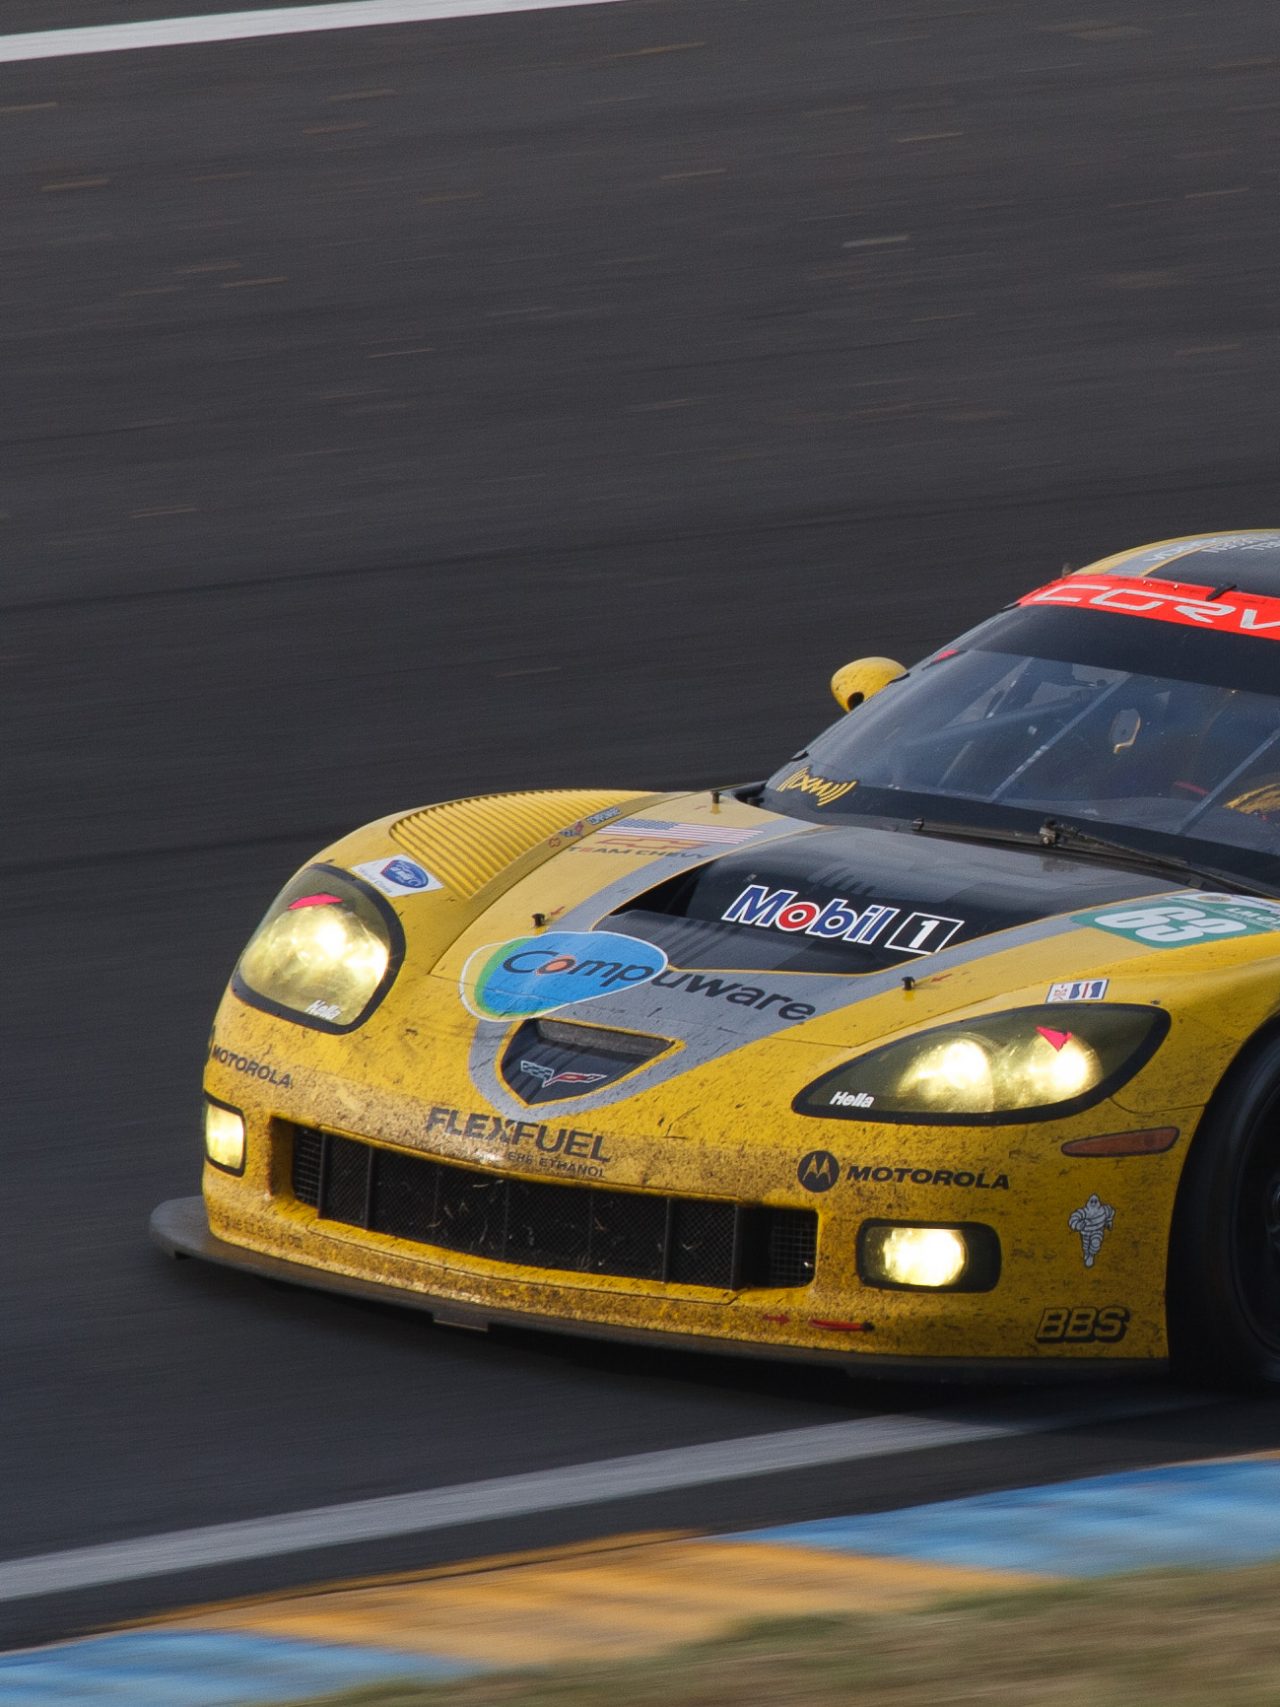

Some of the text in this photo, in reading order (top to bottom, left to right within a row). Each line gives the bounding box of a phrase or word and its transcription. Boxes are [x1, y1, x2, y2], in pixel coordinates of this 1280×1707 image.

[721, 884, 901, 945] Mobil
[1094, 906, 1247, 942] 63
[502, 950, 816, 1021] Compuware
[211, 1043, 291, 1089] MOTOROLA
[829, 1091, 875, 1108] Hella
[425, 1106, 610, 1163] FLEXFUEL
[539, 1157, 606, 1179] ETHANOL
[846, 1165, 1010, 1190] MOTOROLA
[1035, 1305, 1130, 1343] BBS
